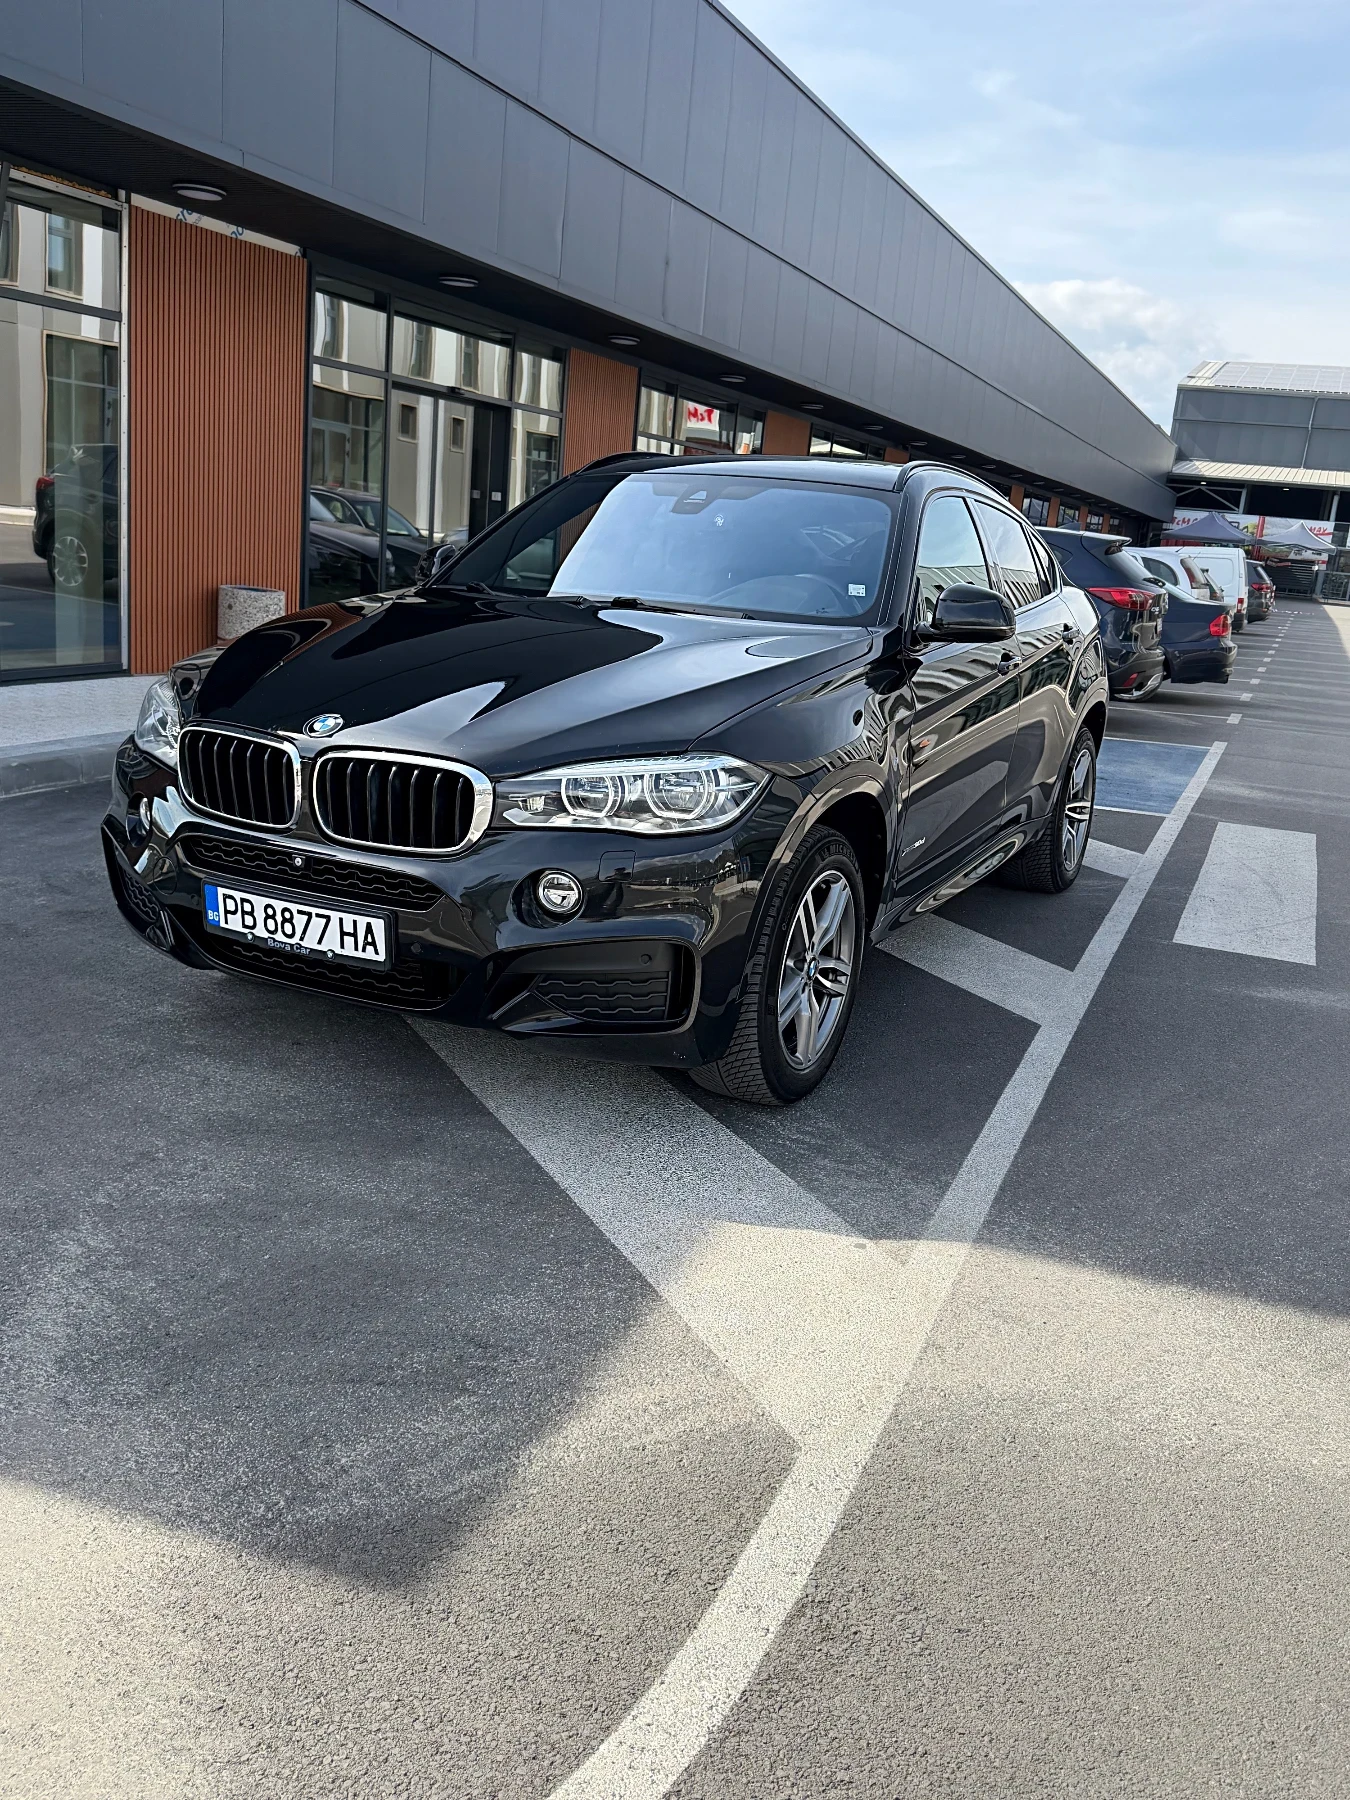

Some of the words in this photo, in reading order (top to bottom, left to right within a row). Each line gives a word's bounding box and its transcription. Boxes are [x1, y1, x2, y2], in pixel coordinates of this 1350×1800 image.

[208, 910, 219, 921] BG
[222, 893, 257, 930] PB
[263, 903, 331, 945] 8877
[338, 917, 380, 956] HA
[293, 944, 311, 955] Car
